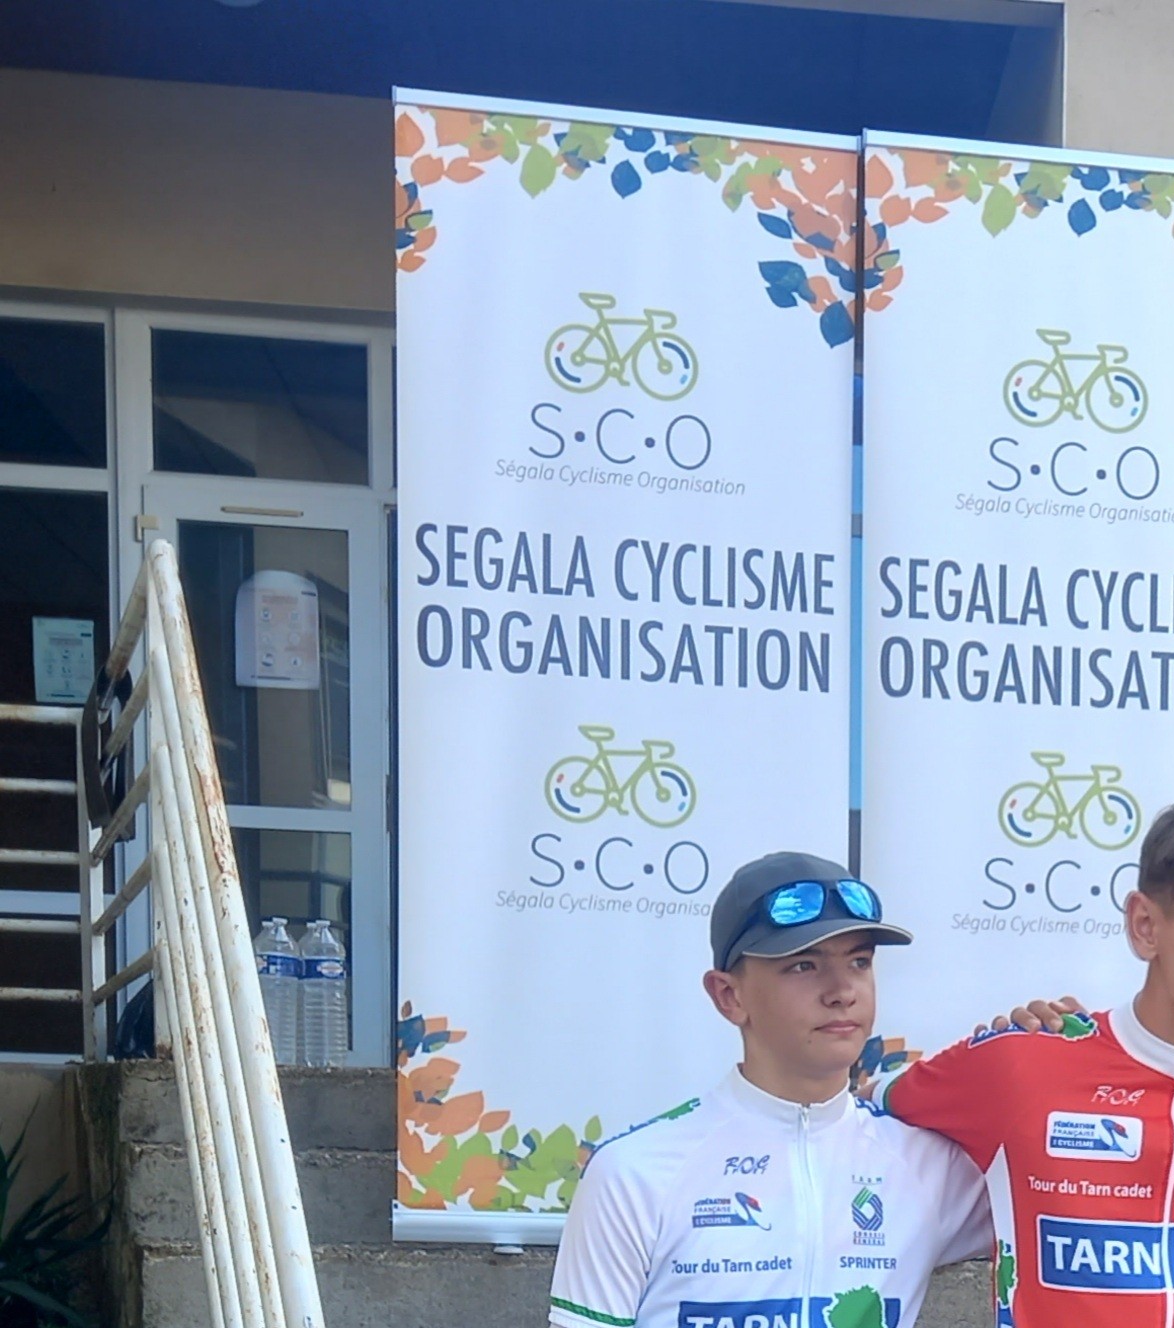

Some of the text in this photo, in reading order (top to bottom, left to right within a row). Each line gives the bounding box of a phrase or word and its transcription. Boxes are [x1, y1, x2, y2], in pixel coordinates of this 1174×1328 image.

[494, 458, 746, 496] Ségala Cyclisme Organisation
[955, 493, 1012, 516] Ségala
[1014, 497, 1086, 519] Cyclisme
[415, 522, 835, 616] SEGALA CYCLISME
[879, 556, 1048, 627] SEGALA
[416, 603, 830, 693] ORGANISATION
[495, 890, 711, 919] Ségala Cyclisme Organisa
[951, 913, 1006, 935] Ségala
[1009, 915, 1081, 937] Cyclisme
[1028, 1175, 1153, 1199] Tour du Tarn cadet
[702, 1259, 720, 1274] du
[722, 1259, 752, 1274] Tarn
[755, 1256, 792, 1271] cadet
[840, 1256, 897, 1270] SPRINTER
[1046, 1235, 1162, 1276] TARN
